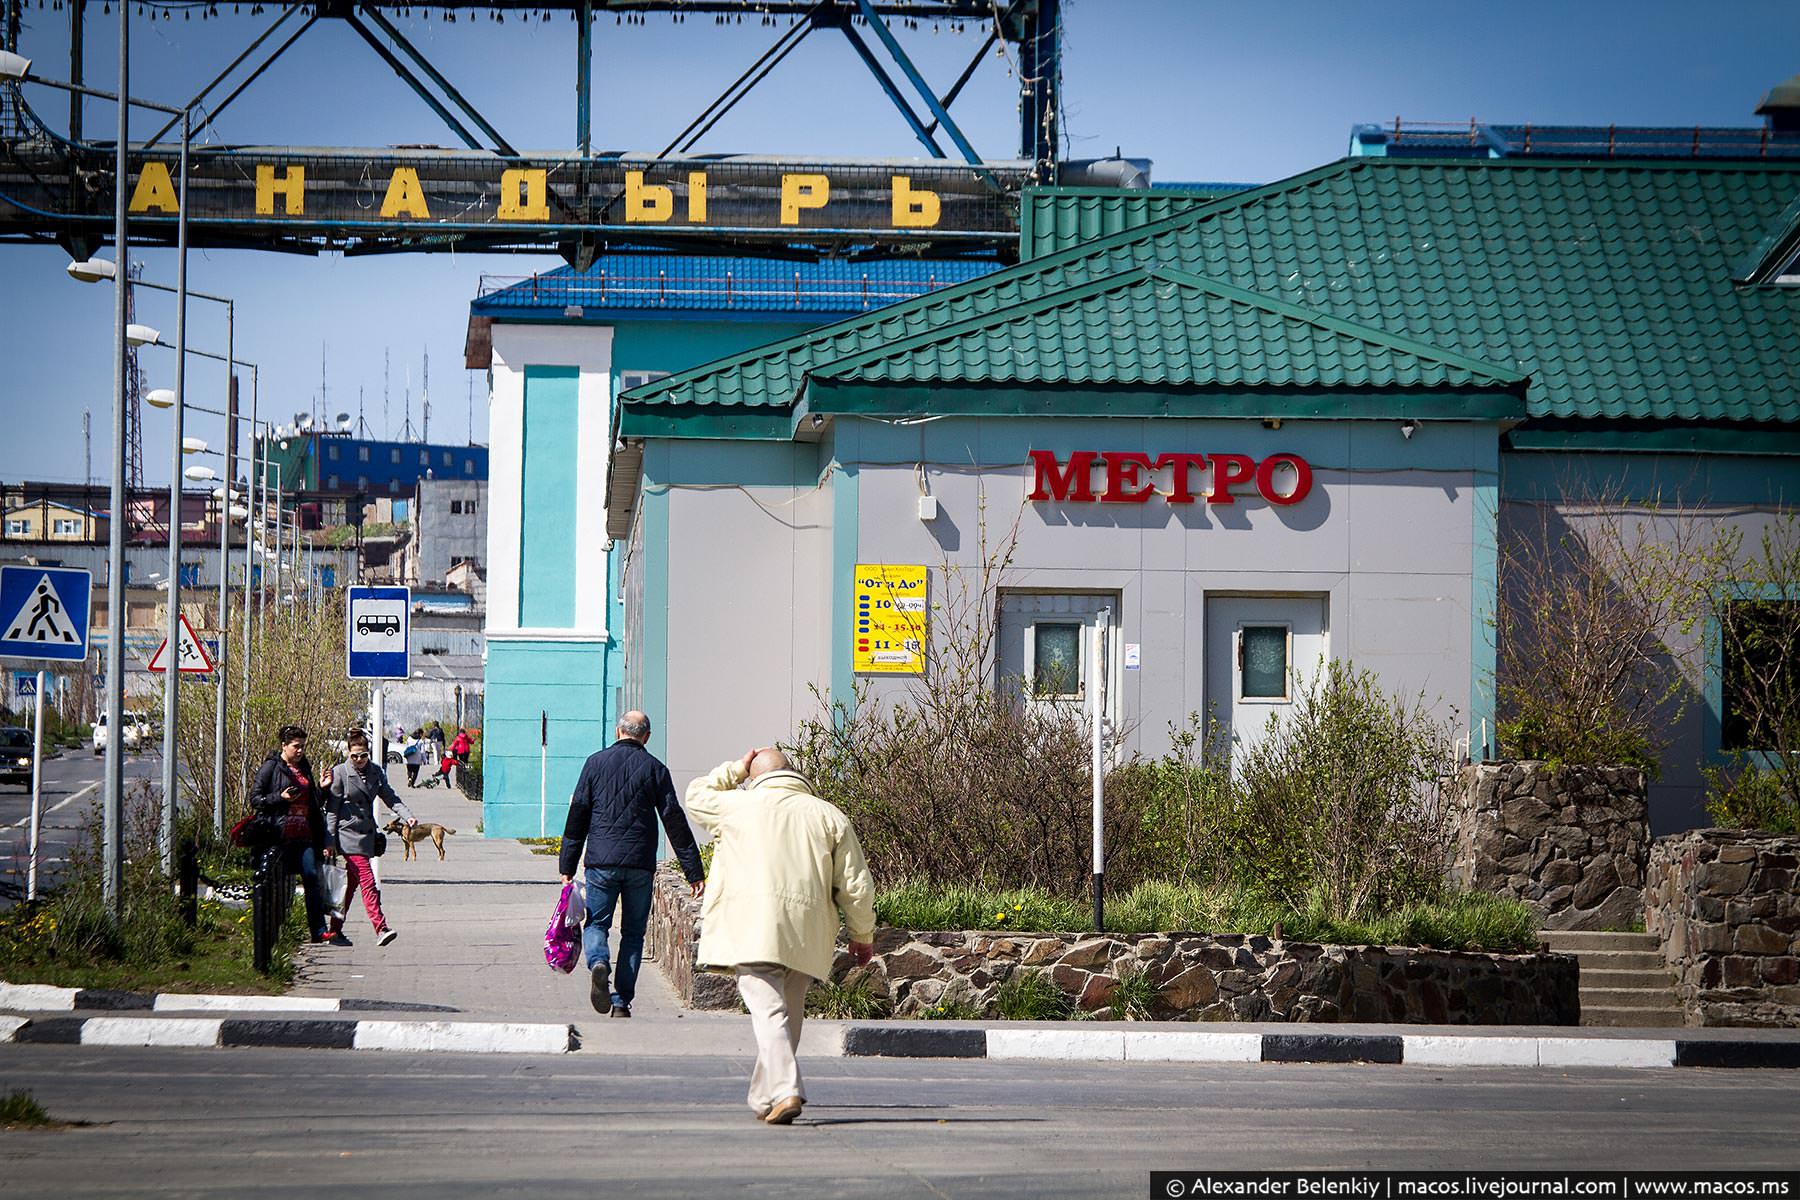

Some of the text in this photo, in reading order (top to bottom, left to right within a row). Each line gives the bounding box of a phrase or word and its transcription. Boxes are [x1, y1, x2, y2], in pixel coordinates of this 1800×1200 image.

[129, 161, 941, 228] АНАДЫРЬ
[1029, 450, 1313, 506] МЕТРО
[875, 599, 892, 609] 10
[875, 640, 890, 649] 11
